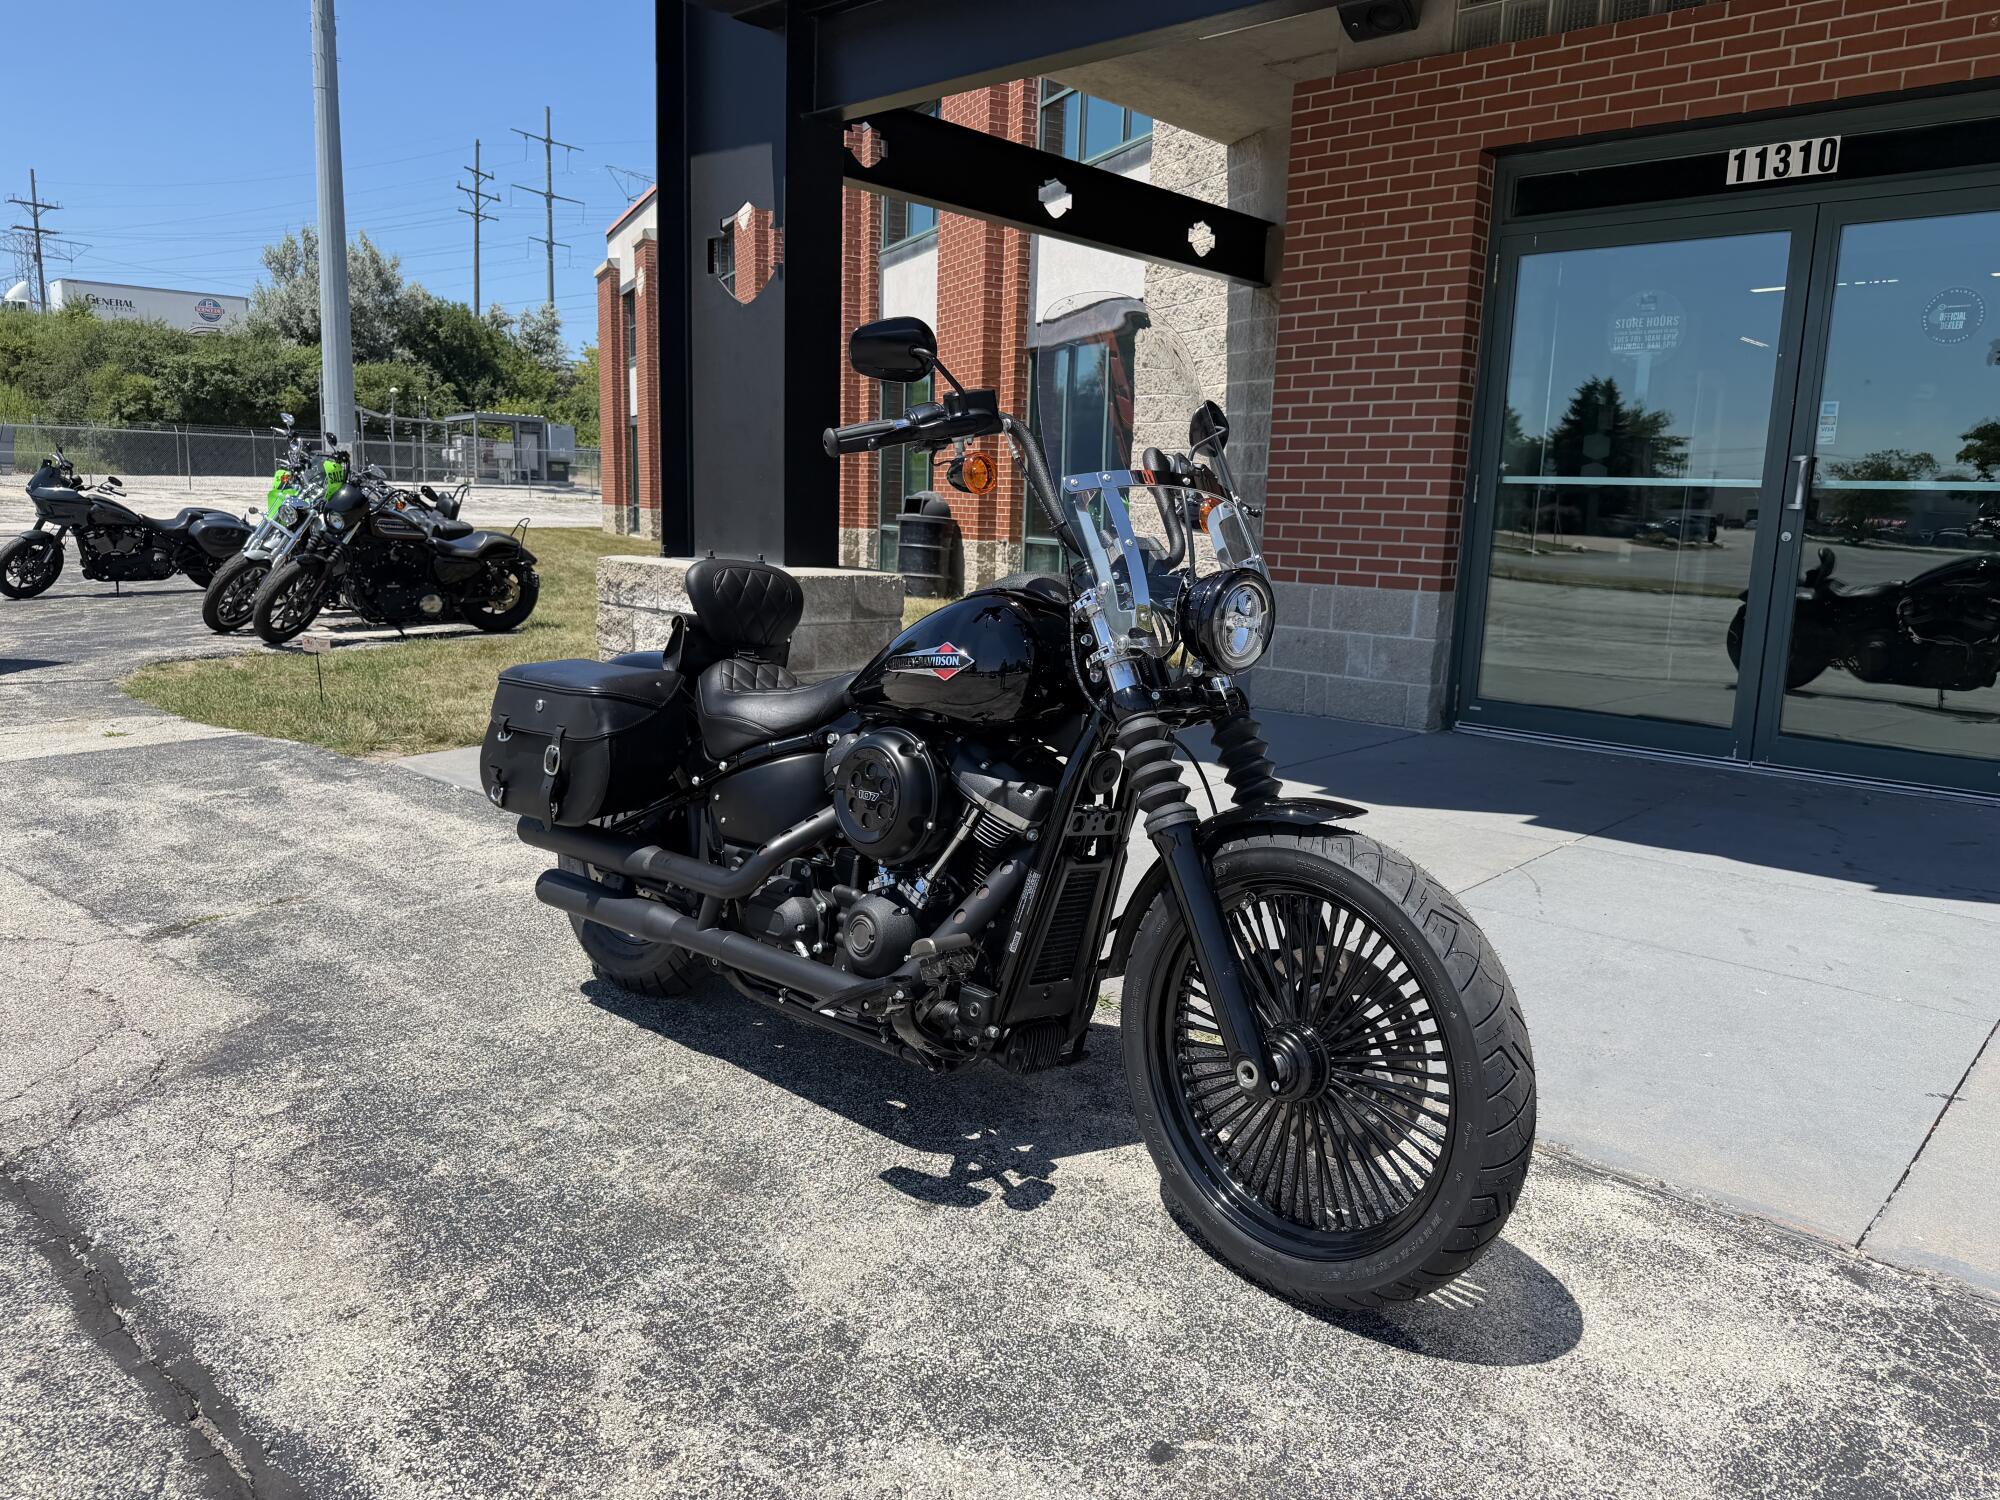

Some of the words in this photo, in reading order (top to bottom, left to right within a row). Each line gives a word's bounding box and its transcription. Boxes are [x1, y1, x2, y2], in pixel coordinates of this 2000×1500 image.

[1733, 137, 1838, 183] 11310
[85, 293, 136, 309] GENERAL
[1615, 317, 1645, 328] STORE
[1646, 315, 1680, 328] HOURS
[1939, 311, 1966, 321] OFFICIAL
[1940, 320, 1964, 330] DEALER
[328, 470, 344, 484] SALE
[858, 789, 880, 802] 107
